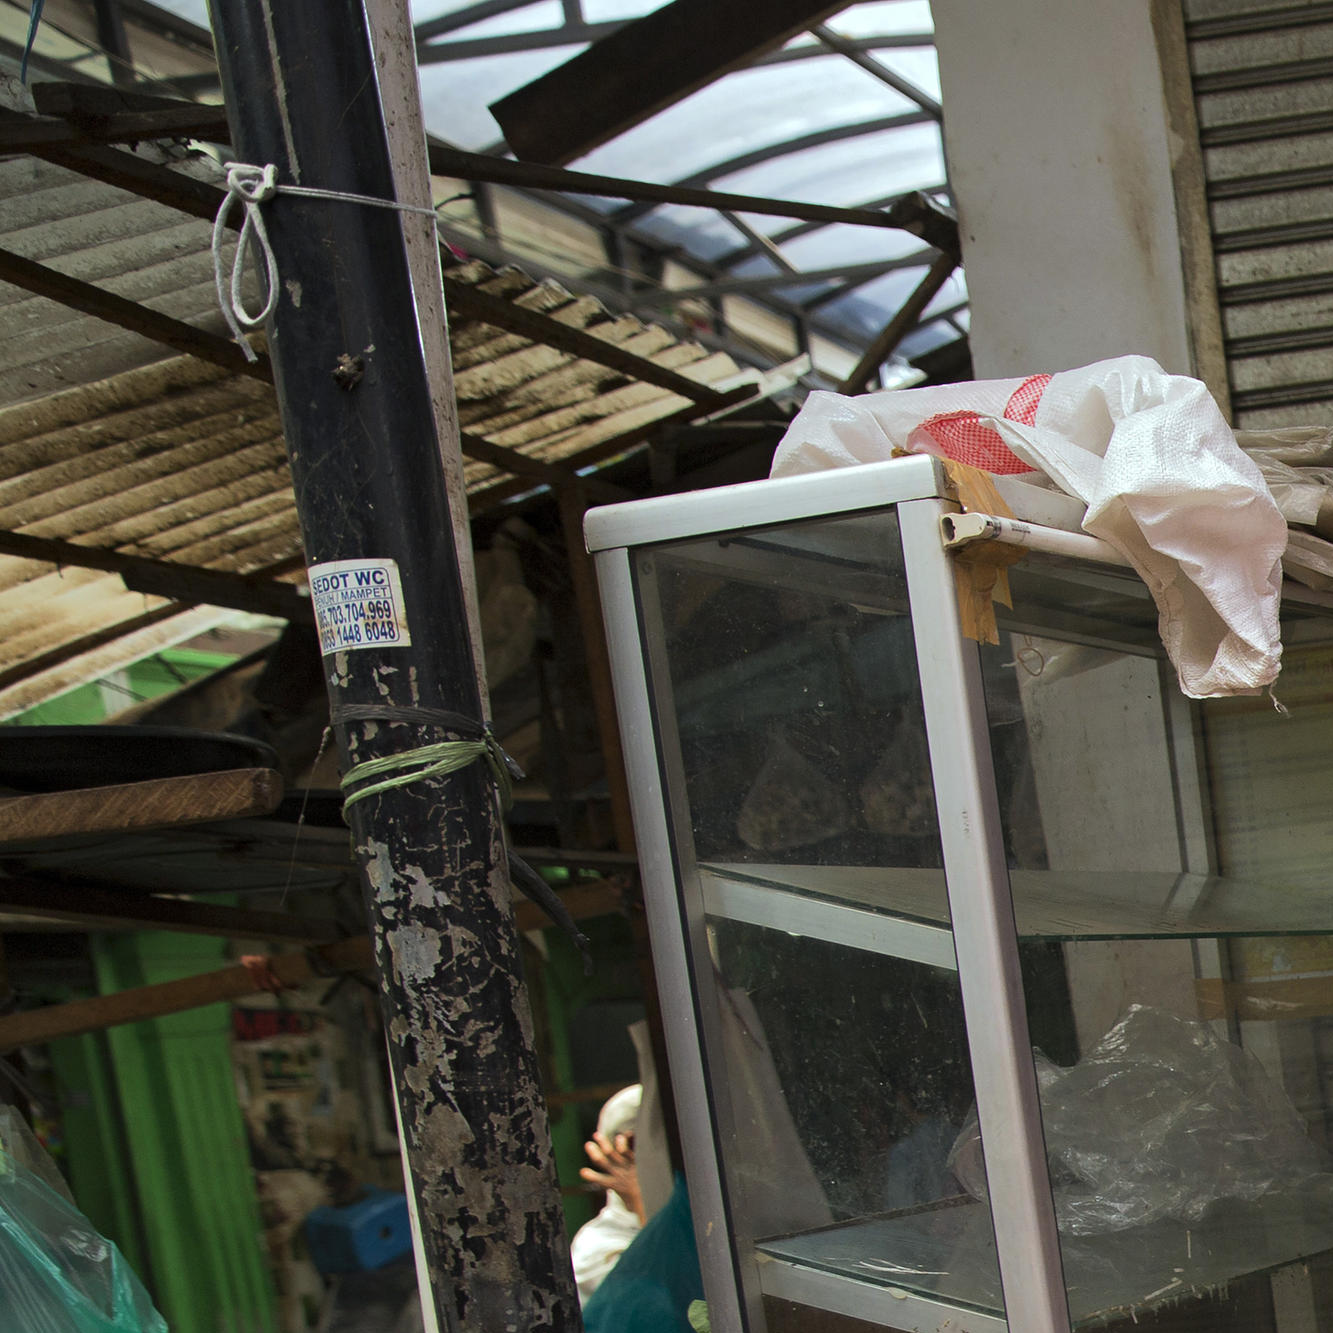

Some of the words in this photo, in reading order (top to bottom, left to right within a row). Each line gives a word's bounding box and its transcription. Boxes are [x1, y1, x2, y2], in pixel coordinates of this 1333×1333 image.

[312, 573, 349, 596] SEDOT
[354, 570, 385, 586] WC
[341, 587, 388, 601] MAMPET
[337, 623, 361, 645] 1448
[365, 620, 395, 641] 6048
